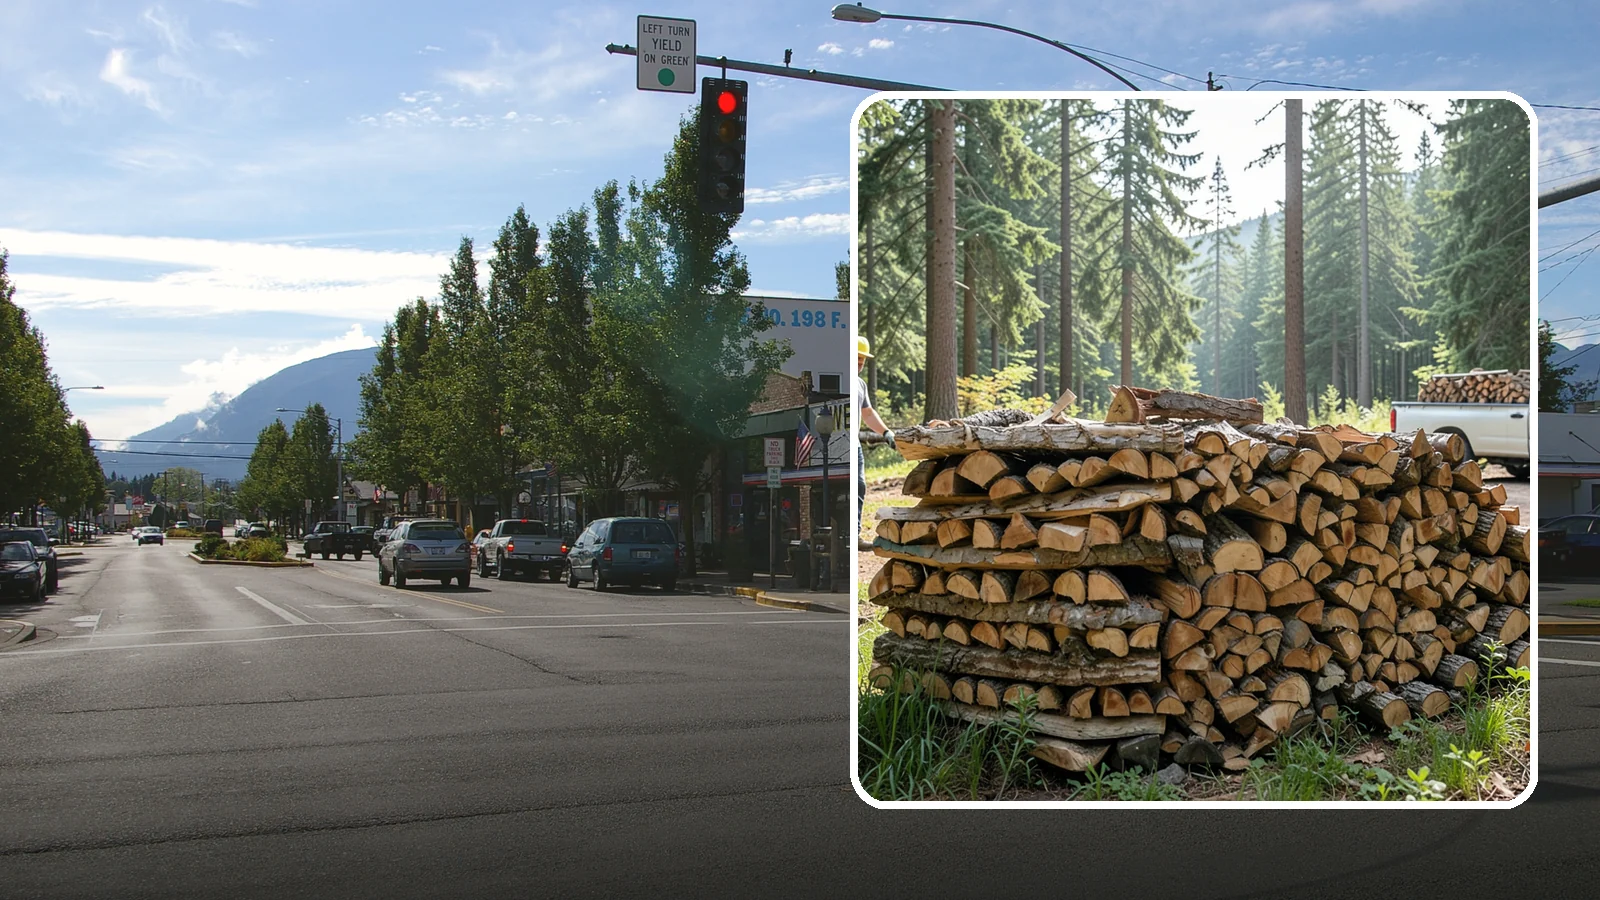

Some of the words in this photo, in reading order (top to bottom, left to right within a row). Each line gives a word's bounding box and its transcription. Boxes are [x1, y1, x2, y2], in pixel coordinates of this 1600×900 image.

[643, 24, 663, 34] LEFT
[668, 26, 690, 36] TURN
[652, 38, 682, 51] YIELD
[644, 53, 656, 63] ON
[661, 55, 688, 66] GREEN
[791, 309, 826, 328] 198
[831, 311, 846, 329] F.
